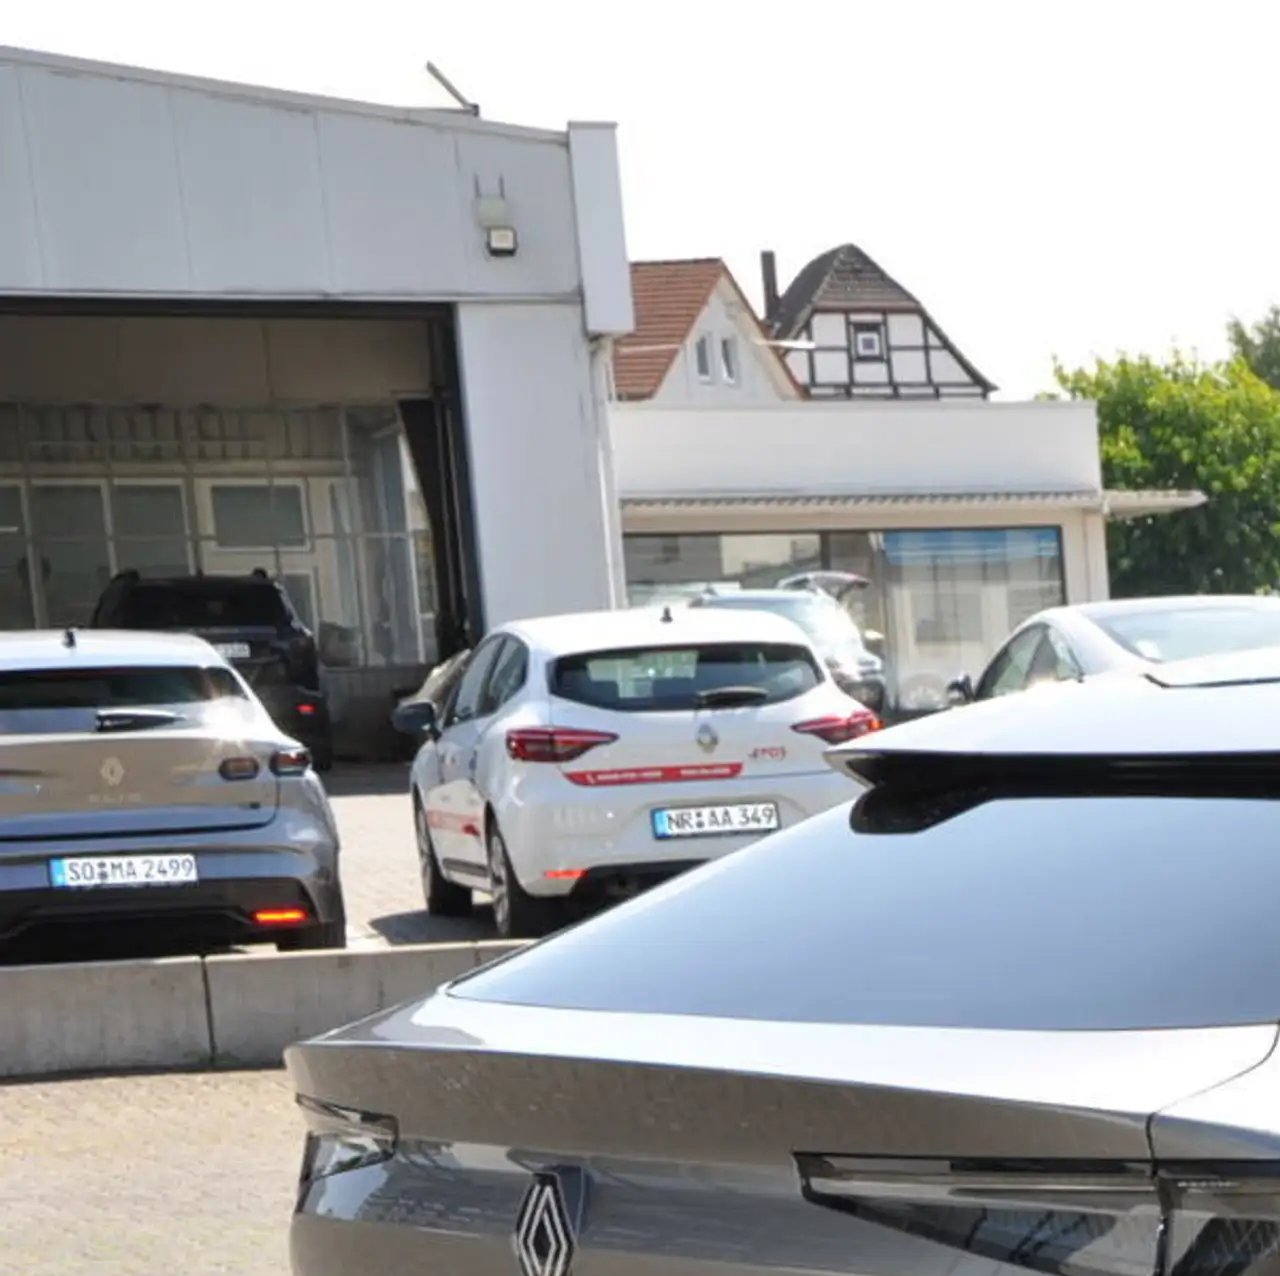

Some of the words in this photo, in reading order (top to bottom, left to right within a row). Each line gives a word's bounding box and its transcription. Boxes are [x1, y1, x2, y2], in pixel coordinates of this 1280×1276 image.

[667, 811, 693, 832] NR
[709, 808, 733, 827] AA
[738, 805, 775, 826] 349
[68, 862, 95, 881] SO
[110, 859, 137, 879] MA
[142, 857, 193, 879] 2499
